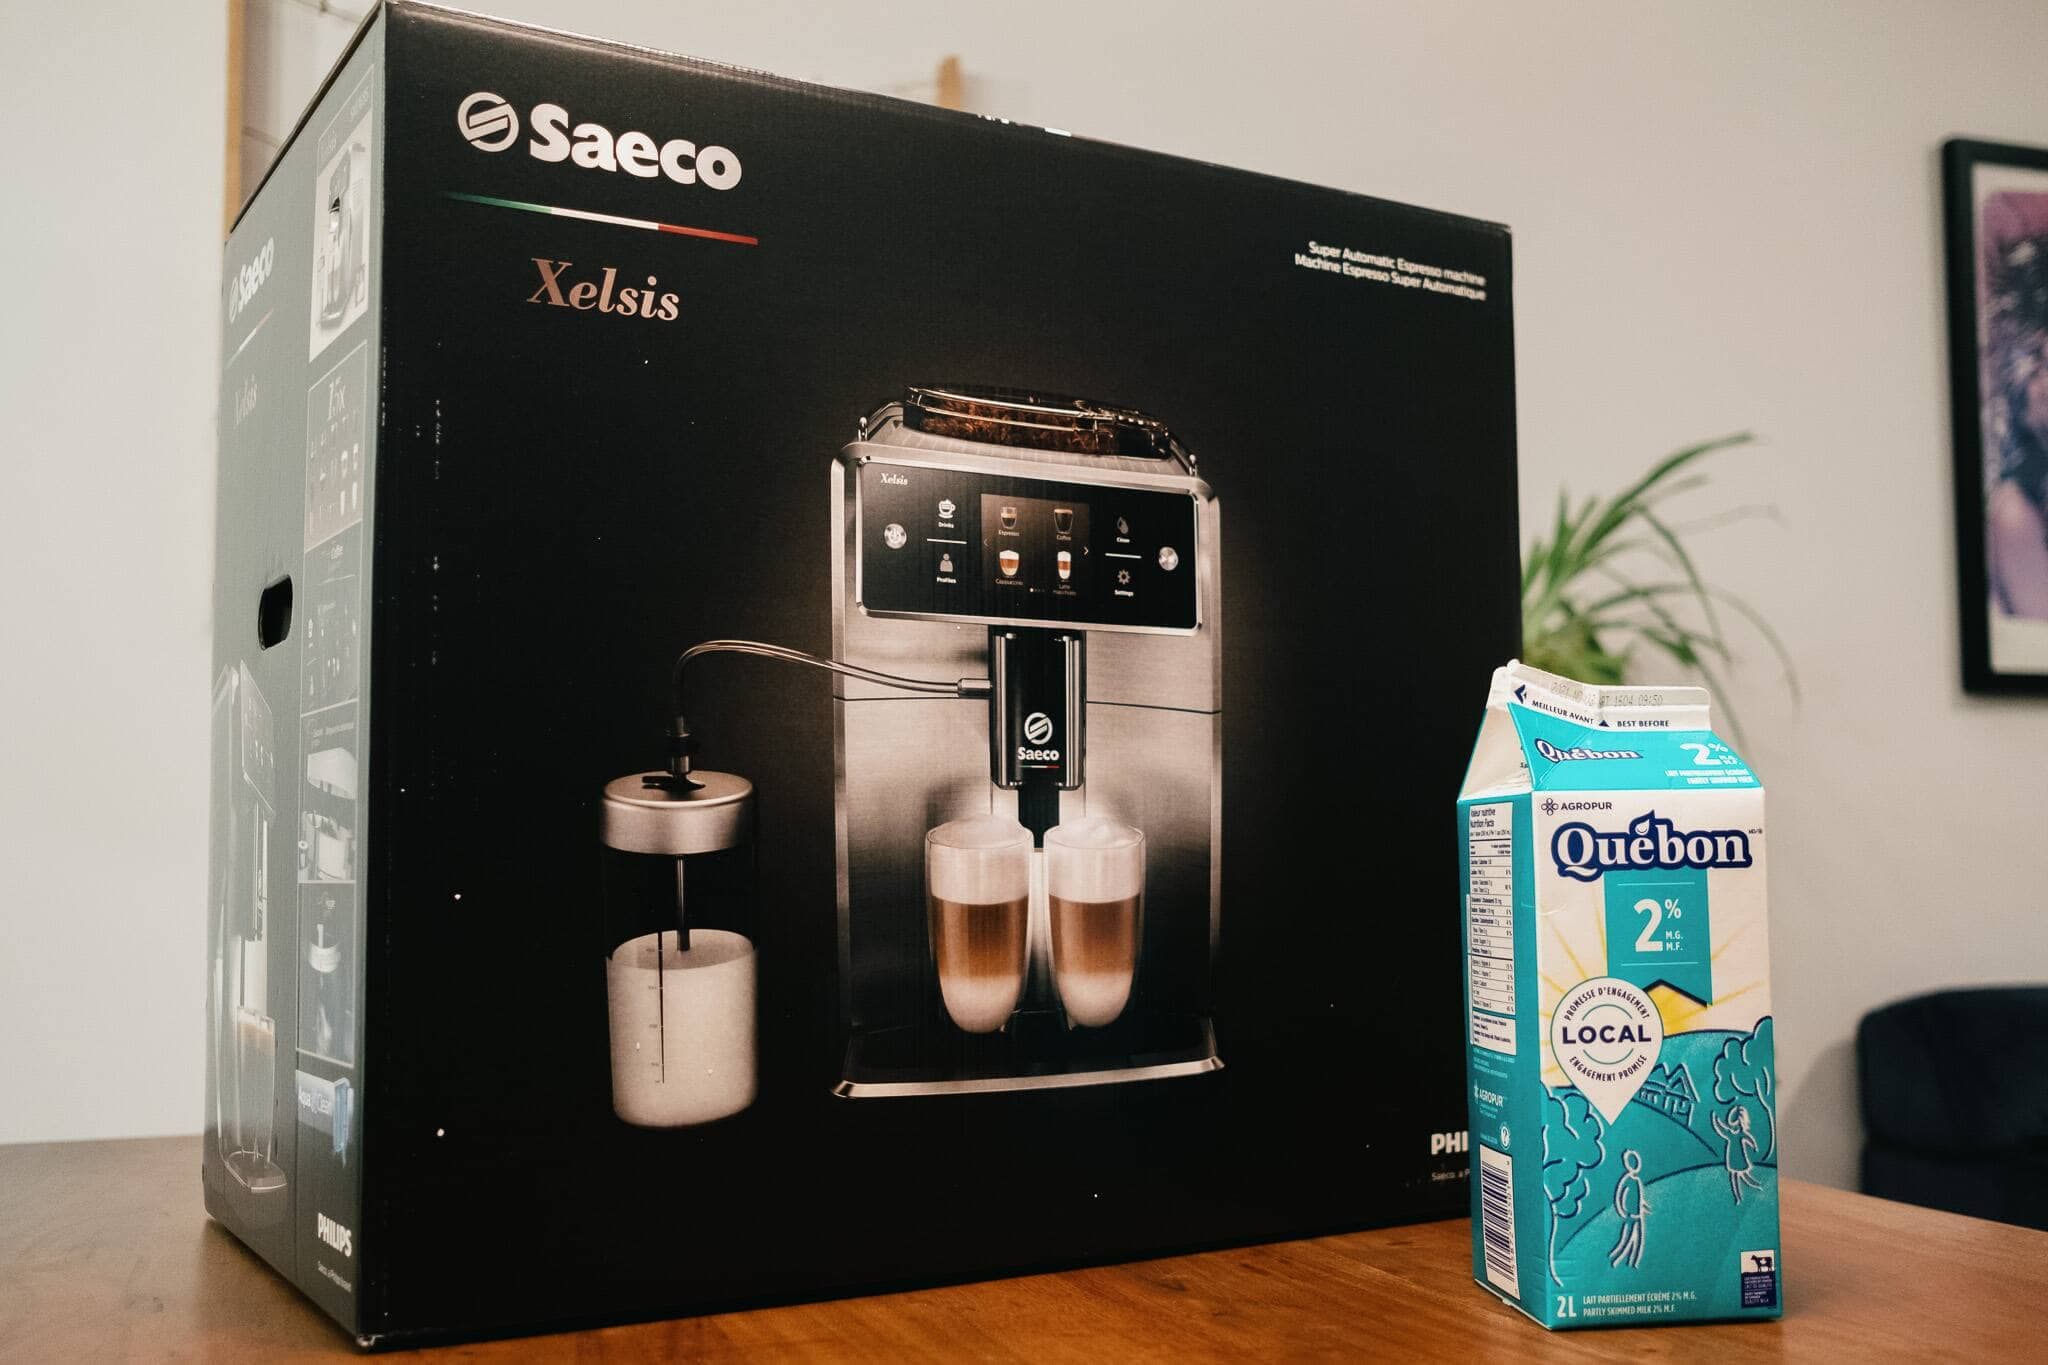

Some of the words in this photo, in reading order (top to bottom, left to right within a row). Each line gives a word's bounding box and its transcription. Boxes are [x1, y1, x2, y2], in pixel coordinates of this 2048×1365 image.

[529, 103, 742, 191] Saeco
[1308, 241, 1341, 258] Super
[1343, 247, 1395, 270] Automatic
[1397, 258, 1442, 278] Espresso
[1443, 269, 1486, 286] machine
[1295, 253, 1341, 273] Machine
[1343, 262, 1390, 283] Espresso
[1390, 271, 1422, 289] Super
[1423, 278, 1487, 301] Automatique
[526, 257, 680, 321] Xelsis
[880, 472, 908, 486] Xelsis
[1531, 700, 1568, 717] MEILLEUR
[1569, 712, 1595, 724] AVANT
[1617, 719, 1636, 728] BEST
[1638, 719, 1669, 728] BEFORE
[1017, 746, 1060, 761] Saeco
[1535, 738, 1642, 763] Québon
[1560, 801, 1613, 811] AGROPUR
[1553, 811, 1751, 882] Québon
[1666, 930, 1684, 940] M.G.
[1666, 941, 1683, 951] M.F.
[1564, 989, 1596, 1021] PROMESSE
[1598, 986, 1651, 1019] D'ENGAGEMENT
[1562, 1024, 1652, 1045] LOCAL
[1569, 1056, 1616, 1082] ENGAGEMENT
[1618, 1054, 1648, 1080] PROMISE
[1479, 1088, 1504, 1108] AGROPUR
[317, 1211, 353, 1258] PHILIPS
[1556, 1295, 1577, 1318] 2L
[1583, 1295, 1597, 1305] LAIT
[1598, 1294, 1646, 1304] PARTIELLEMENT
[1583, 1306, 1606, 1317] PARTLY
[1606, 1305, 1636, 1316] SKIMMED
[1636, 1304, 1652, 1314] MILK
